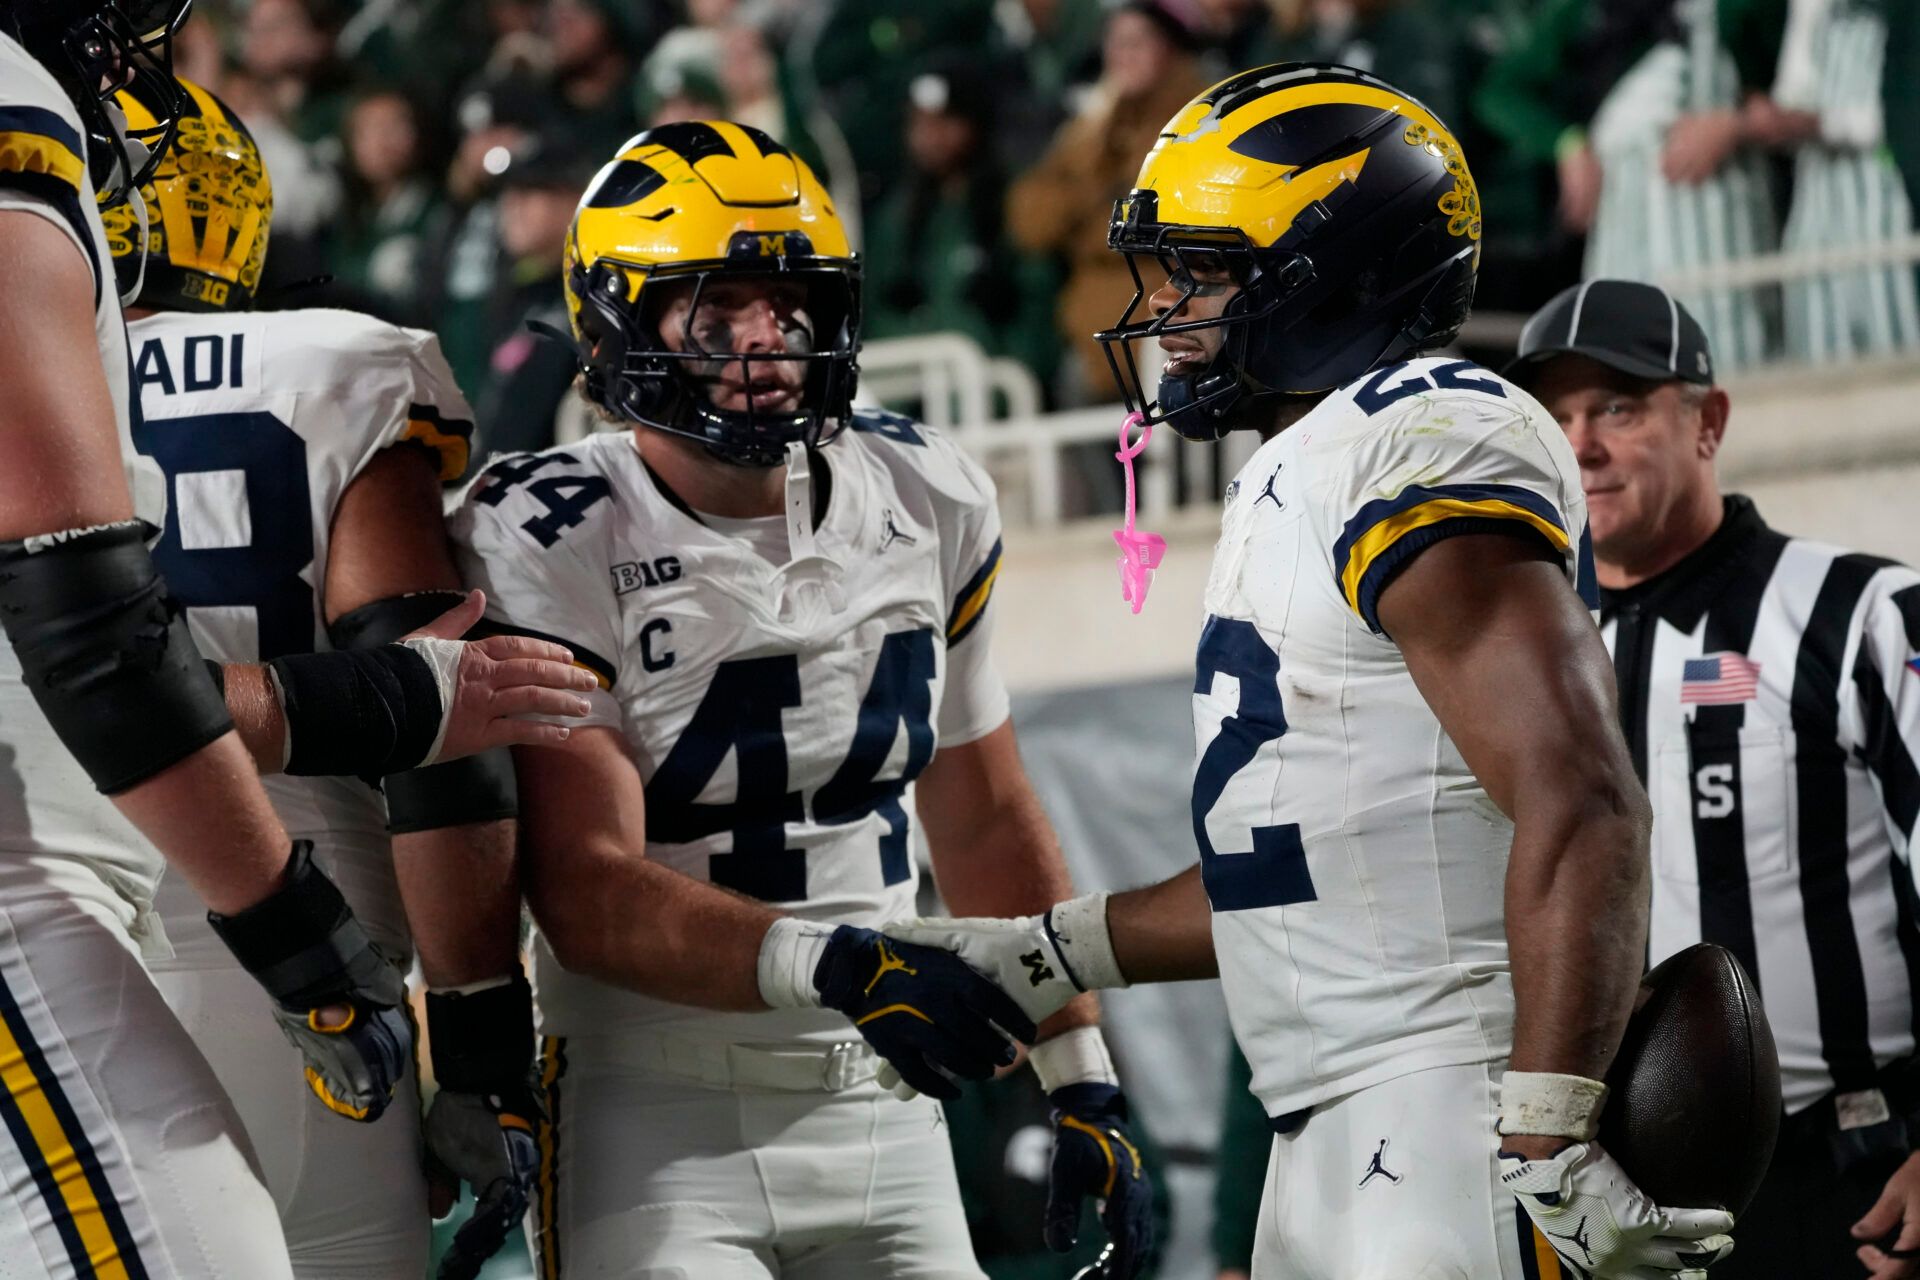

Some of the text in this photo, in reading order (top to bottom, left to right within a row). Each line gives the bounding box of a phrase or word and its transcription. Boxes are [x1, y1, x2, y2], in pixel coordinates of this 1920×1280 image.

[759, 235, 785, 256] M
[473, 452, 616, 549] 44
[639, 617, 676, 674] C
[643, 627, 939, 903] 44
[1696, 764, 1735, 819] S
[1018, 948, 1056, 988] M
